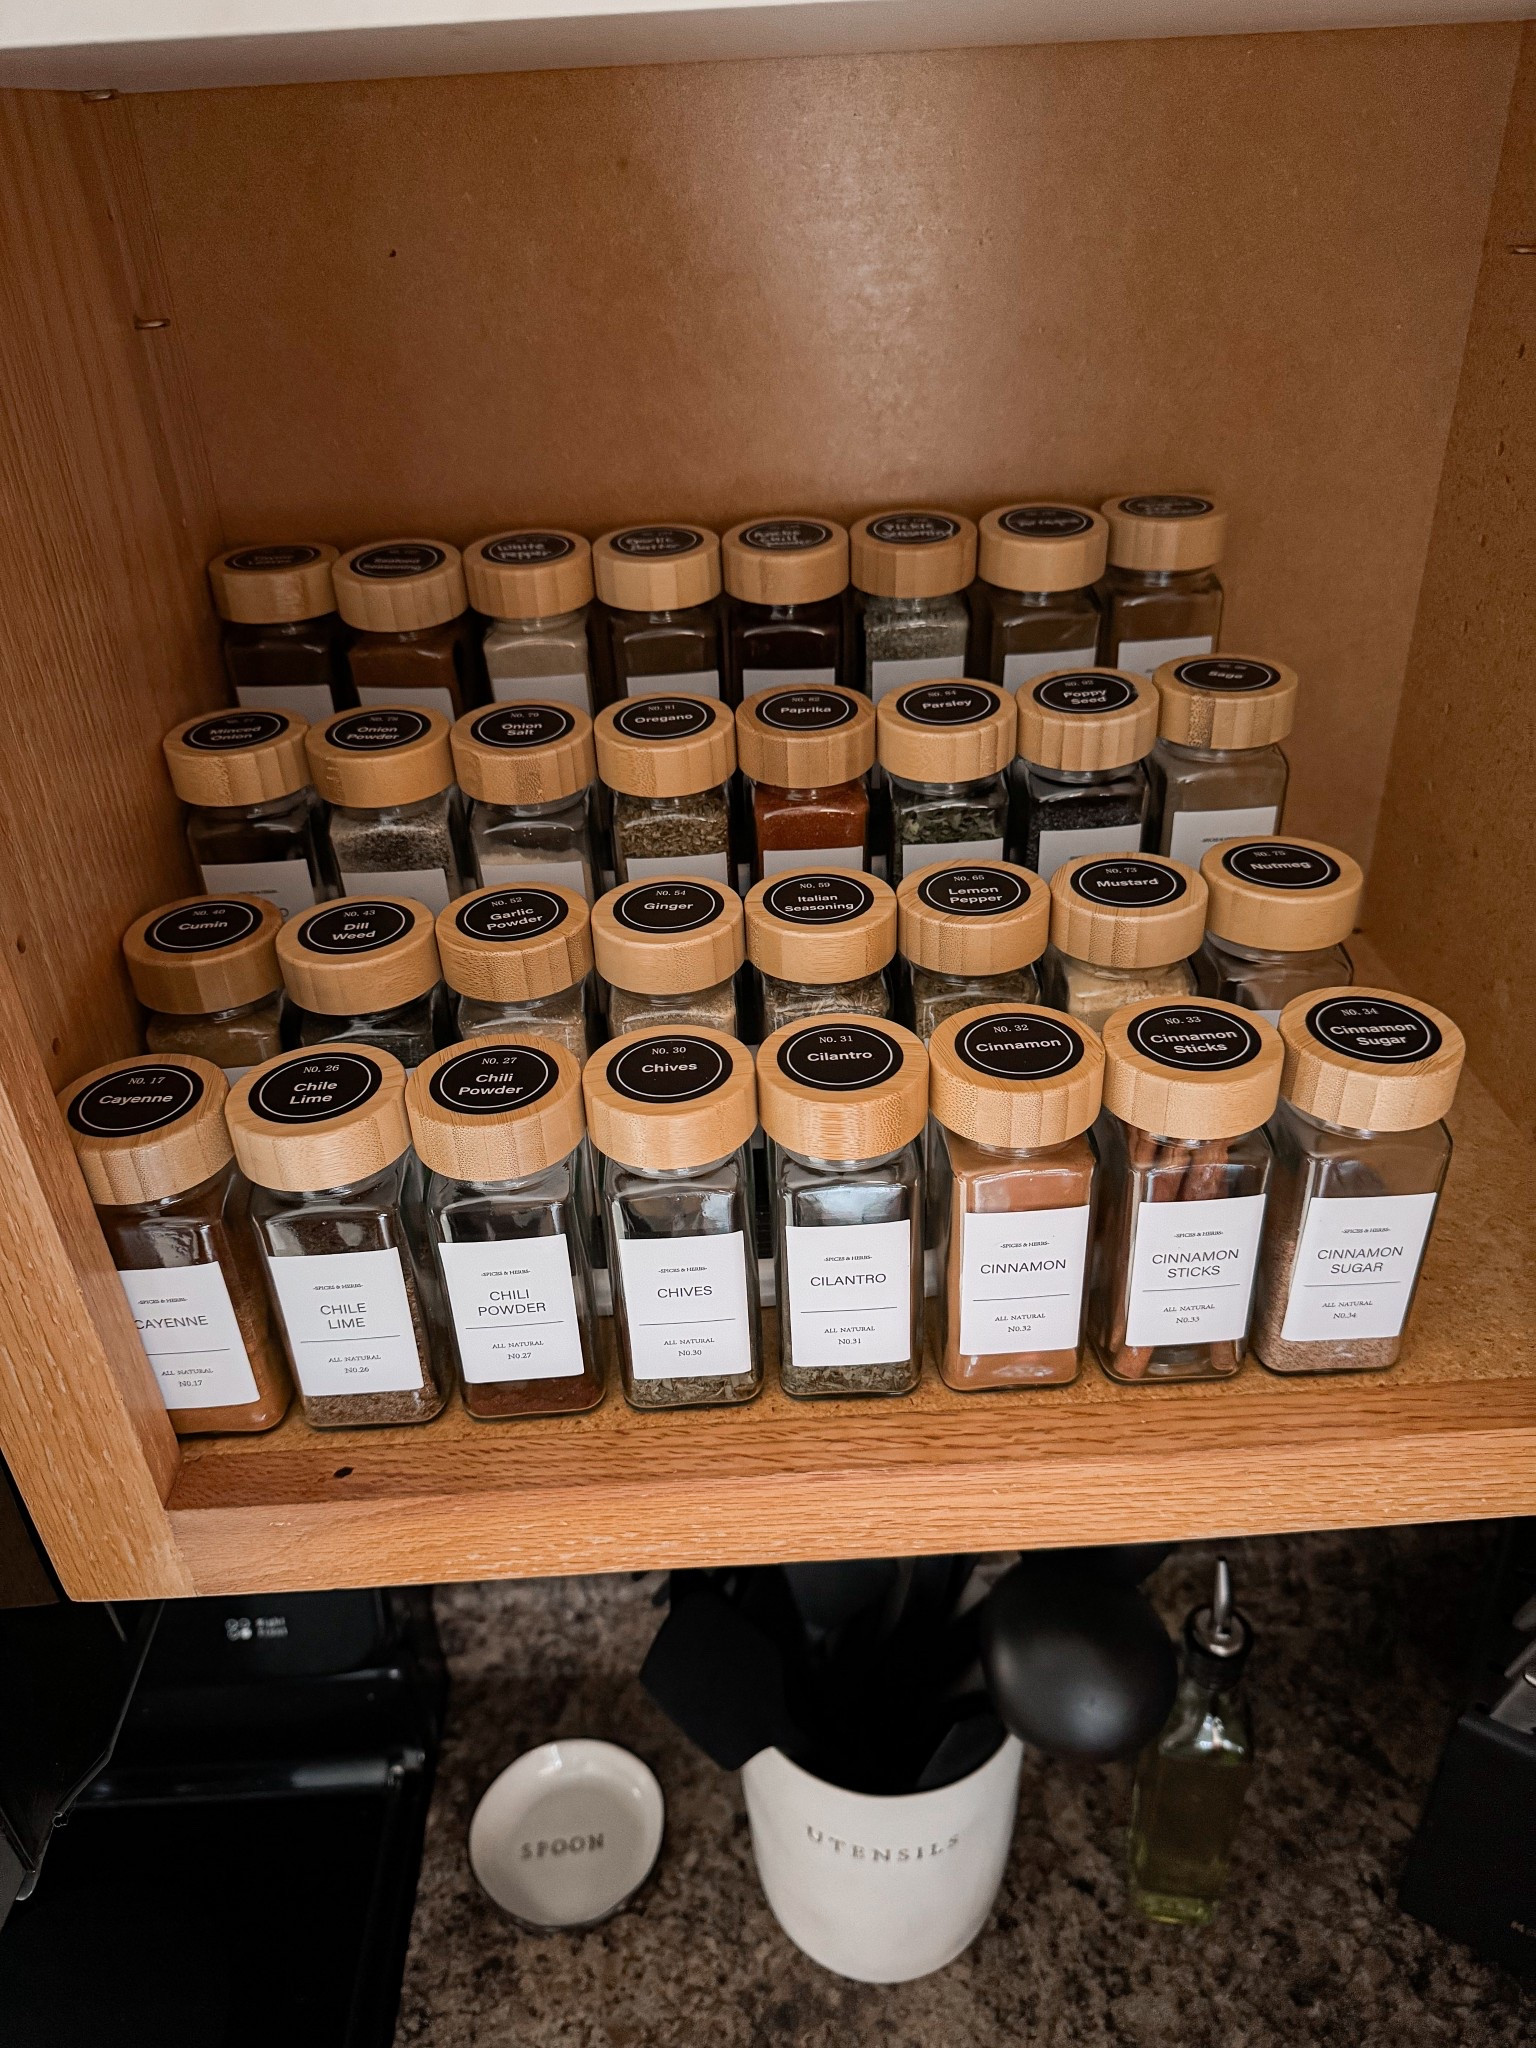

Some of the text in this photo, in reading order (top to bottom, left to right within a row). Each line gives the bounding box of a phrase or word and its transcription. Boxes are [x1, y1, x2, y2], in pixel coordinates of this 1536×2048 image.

[1208, 671, 1243, 680] Sage
[1063, 689, 1107, 699] Poppy
[922, 699, 972, 710] Parsley
[1071, 696, 1107, 705] Seed
[780, 706, 831, 715] Paprika
[635, 713, 693, 724] Oregano
[210, 726, 261, 735] Minced
[502, 722, 542, 731] Onion
[211, 733, 252, 741] Onion
[347, 733, 399, 741] Powder
[1250, 861, 1312, 871] Nutmeg
[1097, 877, 1158, 888] Mustard
[948, 885, 999, 896] Lemon
[491, 896, 522, 908] NO. 52
[797, 893, 838, 903] Italian
[950, 894, 1003, 905] Pepper
[644, 901, 693, 912] Ginger
[784, 902, 854, 913] Seasoning
[490, 907, 534, 921] Garlic
[178, 920, 228, 931] Cumin
[344, 921, 369, 931] Dill
[487, 914, 543, 931] Powder
[332, 930, 376, 942] Weed
[1341, 1007, 1378, 1017] NO. 34
[1165, 1015, 1201, 1025] NO. 33
[993, 1023, 1029, 1033] NO. 32
[1330, 1021, 1417, 1036] Cinnamon
[819, 1034, 853, 1044] NO. 31
[1150, 1029, 1237, 1044] Cinnamon
[1357, 1034, 1407, 1048] Sugar
[651, 1046, 686, 1055] NO. 30
[976, 1037, 1061, 1053] Cinnamon
[1173, 1041, 1227, 1055] Sticks
[481, 1056, 517, 1066] NO. 27
[807, 1049, 873, 1062] Cilantro
[303, 1064, 340, 1074] NO. 26
[642, 1061, 698, 1074] Chives
[128, 1076, 166, 1086] NO. 17
[475, 1072, 513, 1083] Chili
[293, 1080, 337, 1092] Chile
[458, 1084, 523, 1096] Powder
[99, 1093, 173, 1107] Cayenne
[289, 1093, 332, 1105] Lime
[1152, 1249, 1239, 1265] CINNAMON
[1317, 1246, 1404, 1260] CINNAMON
[980, 1259, 1066, 1275] CINNAMON
[1167, 1265, 1220, 1279] STICKS
[1330, 1262, 1384, 1274] SUGAR
[810, 1273, 886, 1287] CILANTRO
[489, 1289, 530, 1301] CHILI
[657, 1285, 713, 1299] CHIVES
[320, 1302, 367, 1316] CHILE
[478, 1302, 546, 1317] POWDER
[1179, 1304, 1215, 1312] NATURAL
[134, 1315, 209, 1330] CAYENNE
[328, 1317, 366, 1330] LIME
[840, 1325, 875, 1333] NATURAL
[1008, 1325, 1031, 1333] NO.32
[508, 1340, 544, 1348] NATURAL
[679, 1337, 715, 1345] NATURAL
[345, 1354, 381, 1362] NATURAL
[507, 1352, 531, 1360] NO.27
[678, 1349, 702, 1357] NO.30
[179, 1379, 203, 1388] NO.17
[521, 1832, 604, 1860] SPOON
[807, 1825, 959, 1862] UTENSILS
